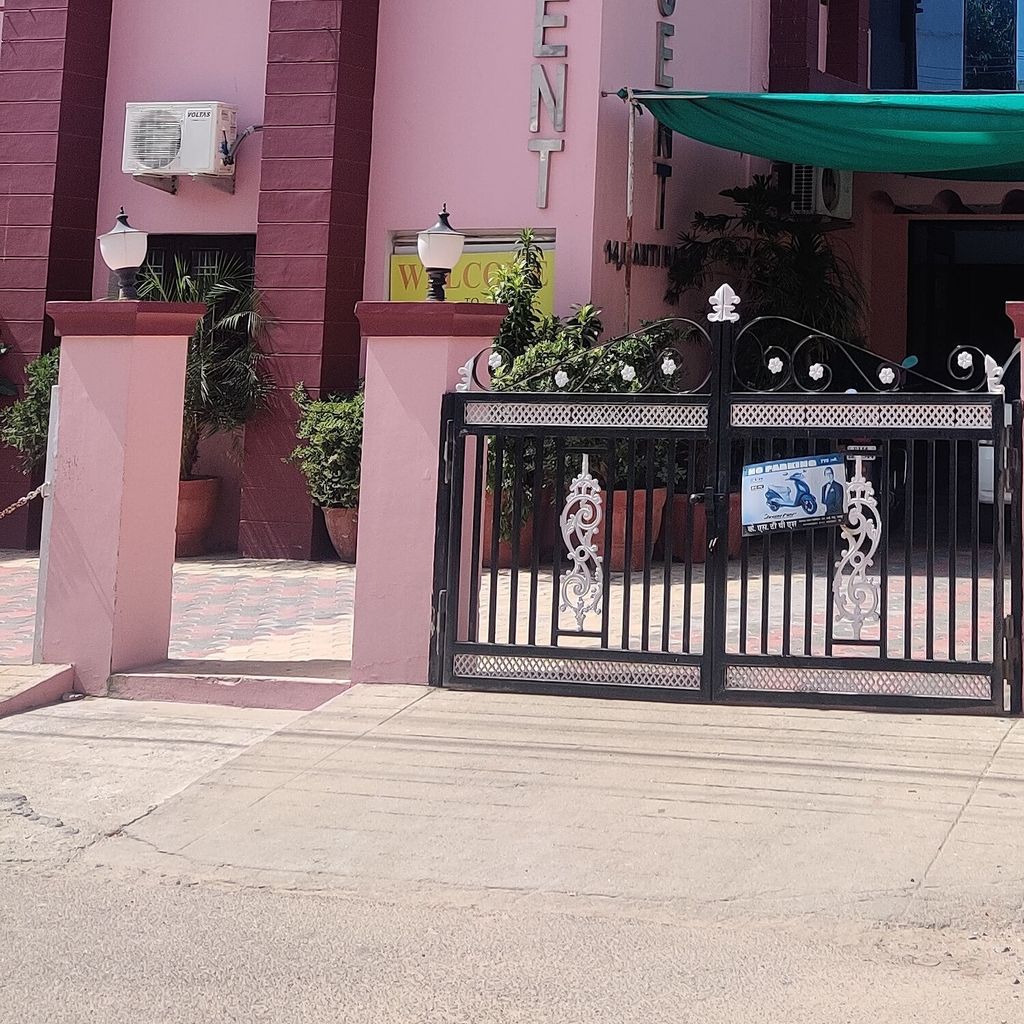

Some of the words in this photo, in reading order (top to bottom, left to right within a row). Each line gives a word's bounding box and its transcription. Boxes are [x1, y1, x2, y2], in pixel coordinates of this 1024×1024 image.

[398, 260, 549, 291] WLCO
[748, 466, 764, 476] NO
[765, 460, 817, 473] PARKING
